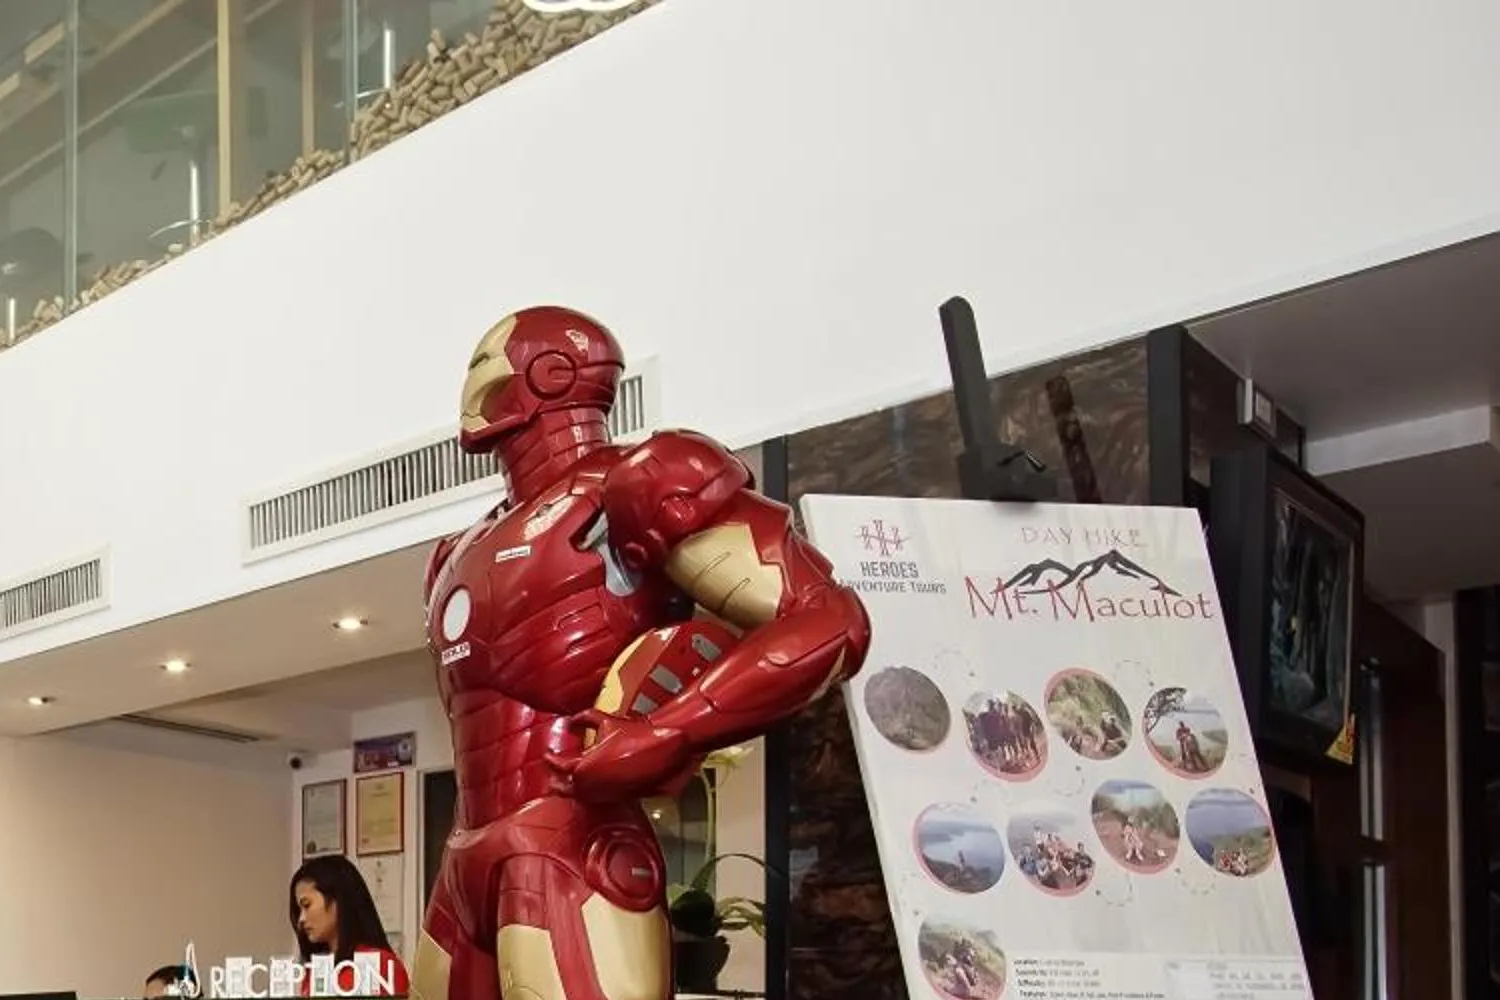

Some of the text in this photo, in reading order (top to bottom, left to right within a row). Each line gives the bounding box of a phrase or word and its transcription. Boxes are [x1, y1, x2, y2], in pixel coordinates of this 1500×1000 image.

[859, 561, 920, 579] HEROES
[964, 575, 1038, 621] Mt.
[210, 958, 395, 998] RECEPTION
